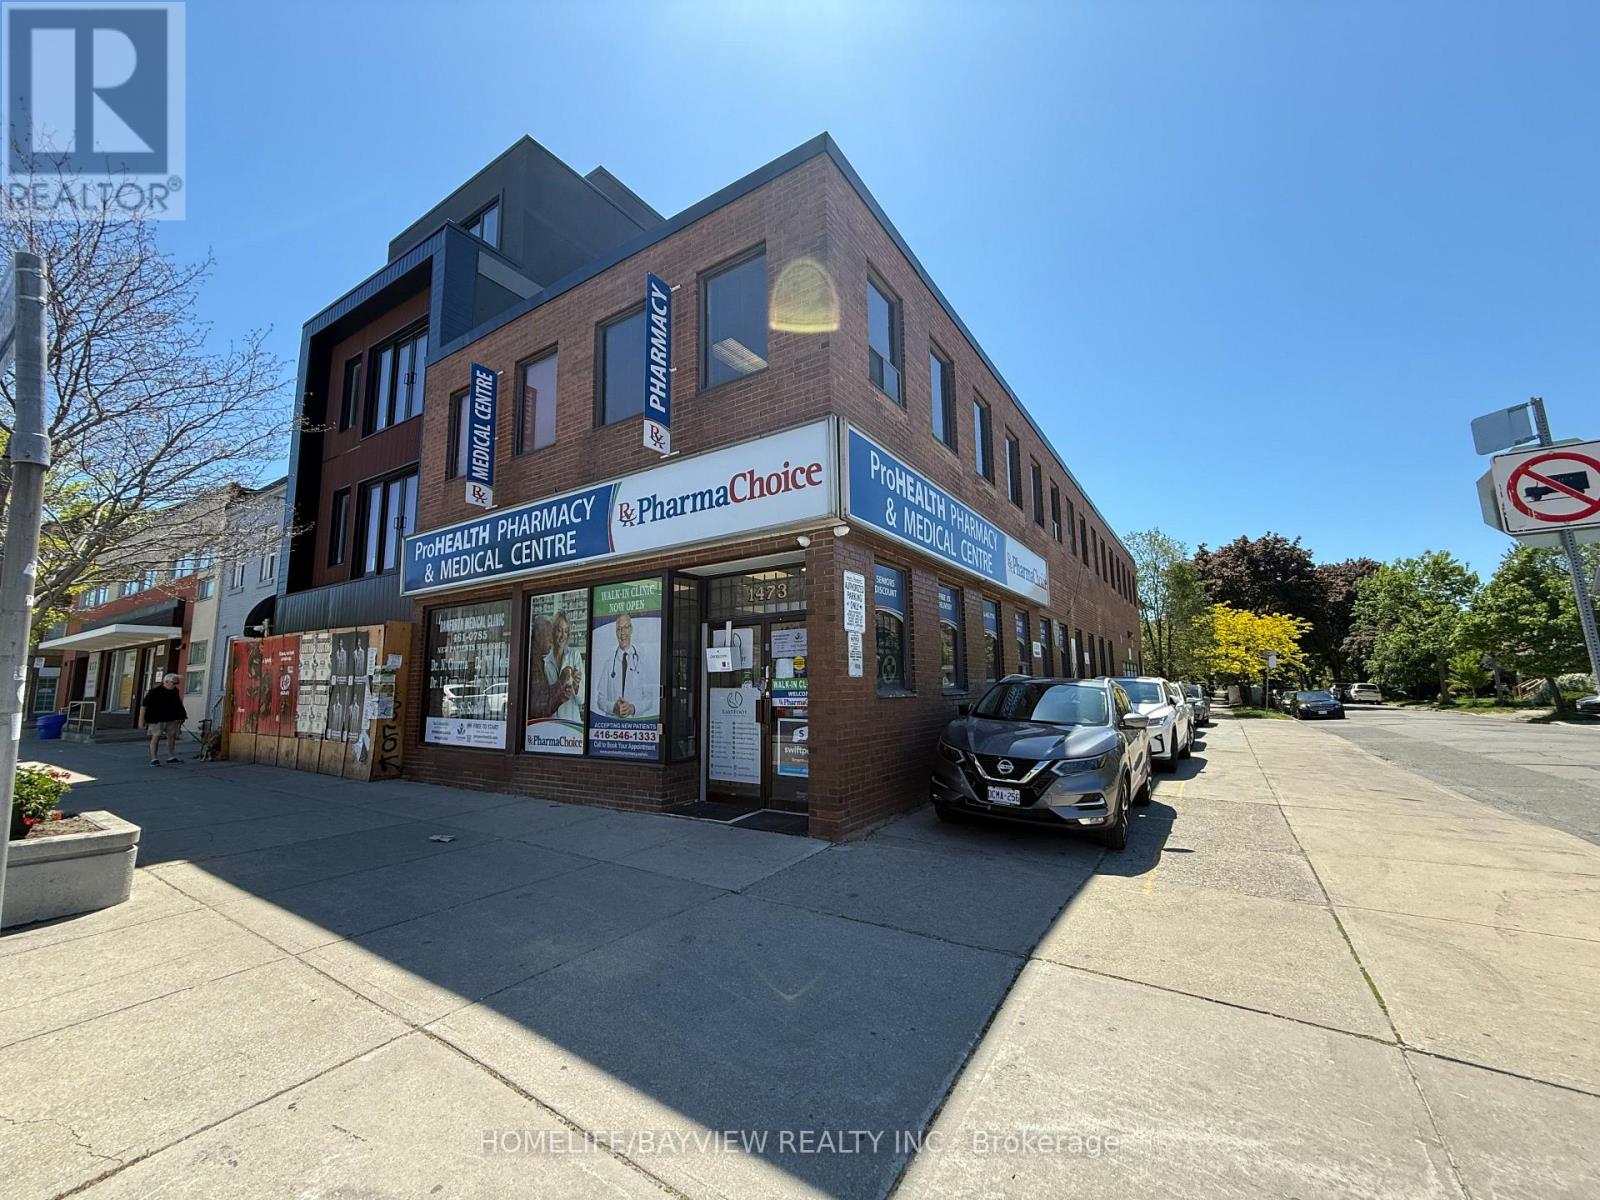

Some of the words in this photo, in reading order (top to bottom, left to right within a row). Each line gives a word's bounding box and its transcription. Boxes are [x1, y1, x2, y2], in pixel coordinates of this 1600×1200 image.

[649, 283, 668, 413] PHARMACY
[475, 370, 493, 420] CENTRE
[471, 424, 491, 481] MEDICAL
[637, 460, 823, 525] PharmaChoice
[870, 450, 946, 521] ProHEALTH
[950, 504, 998, 551] PHARMACY
[415, 523, 490, 561] ProHEALTH
[498, 495, 596, 541] PHARMACY
[885, 497, 897, 528] &
[904, 506, 957, 557] MEDICAL
[960, 539, 993, 574] CENTRE
[424, 564, 434, 583] &
[440, 547, 501, 581] MEDICAL
[511, 531, 577, 565] CENTRE
[876, 575, 896, 588] SENIORS
[601, 588, 629, 602] WALK-IN
[631, 584, 655, 597] CLINIC
[748, 583, 788, 602] 1473
[874, 585, 897, 598] DISCOUNT
[609, 602, 624, 614] NOW
[627, 599, 645, 611] OPEN
[487, 613, 505, 628] CLINIC
[773, 680, 798, 689] WALK-IN
[533, 735, 583, 749] PharmaChoice
[594, 730, 656, 742] 416-546-1333
[607, 741, 618, 749] Book
[628, 743, 656, 751] Appointment
